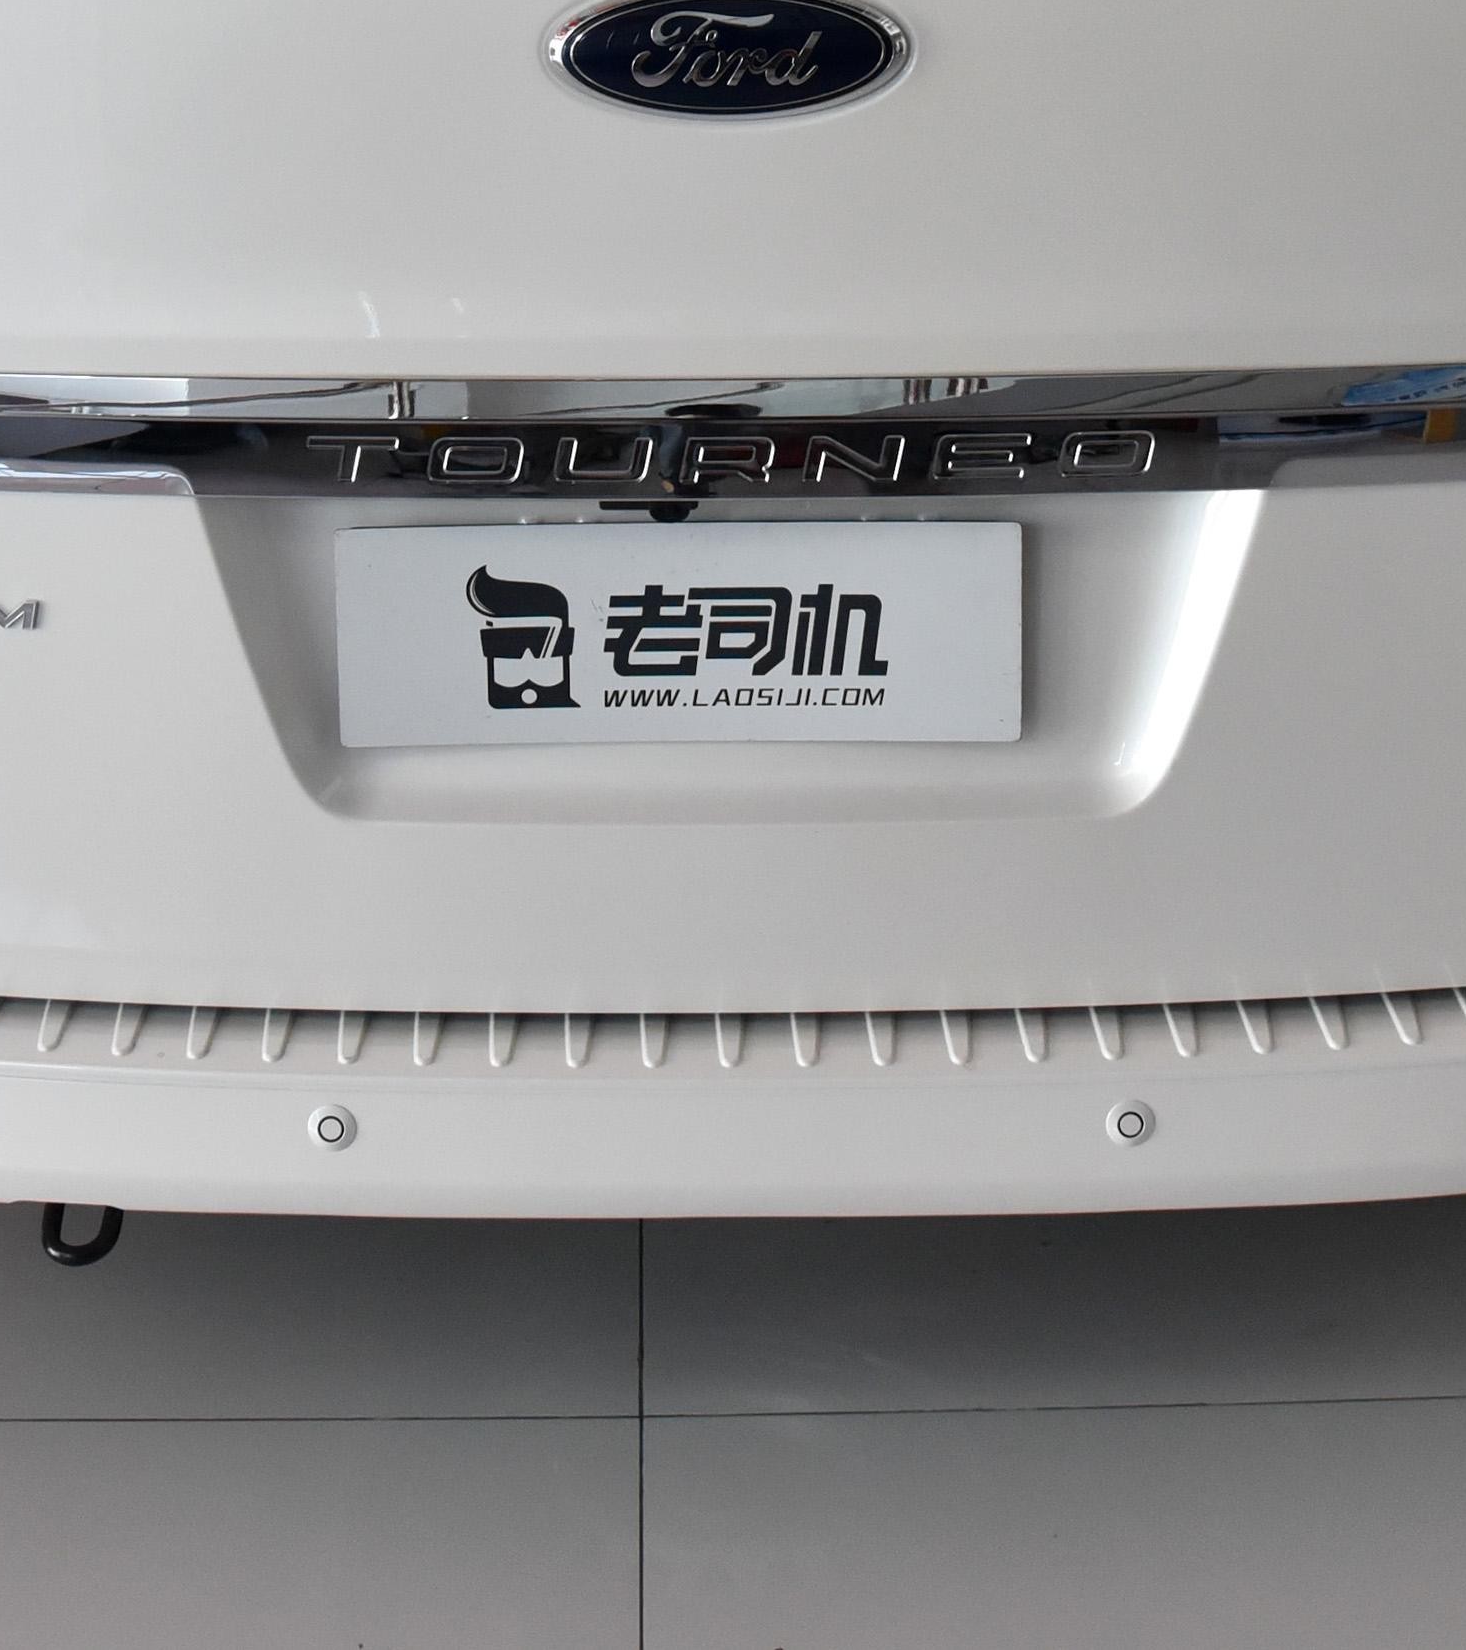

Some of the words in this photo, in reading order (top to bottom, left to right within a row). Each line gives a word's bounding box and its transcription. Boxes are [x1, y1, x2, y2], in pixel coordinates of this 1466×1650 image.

[630, 10, 823, 88] Ford
[305, 430, 1157, 485] TOURNEO
[603, 583, 889, 677] 老司机
[602, 686, 887, 709] WWW.LAOSIJI.COM
